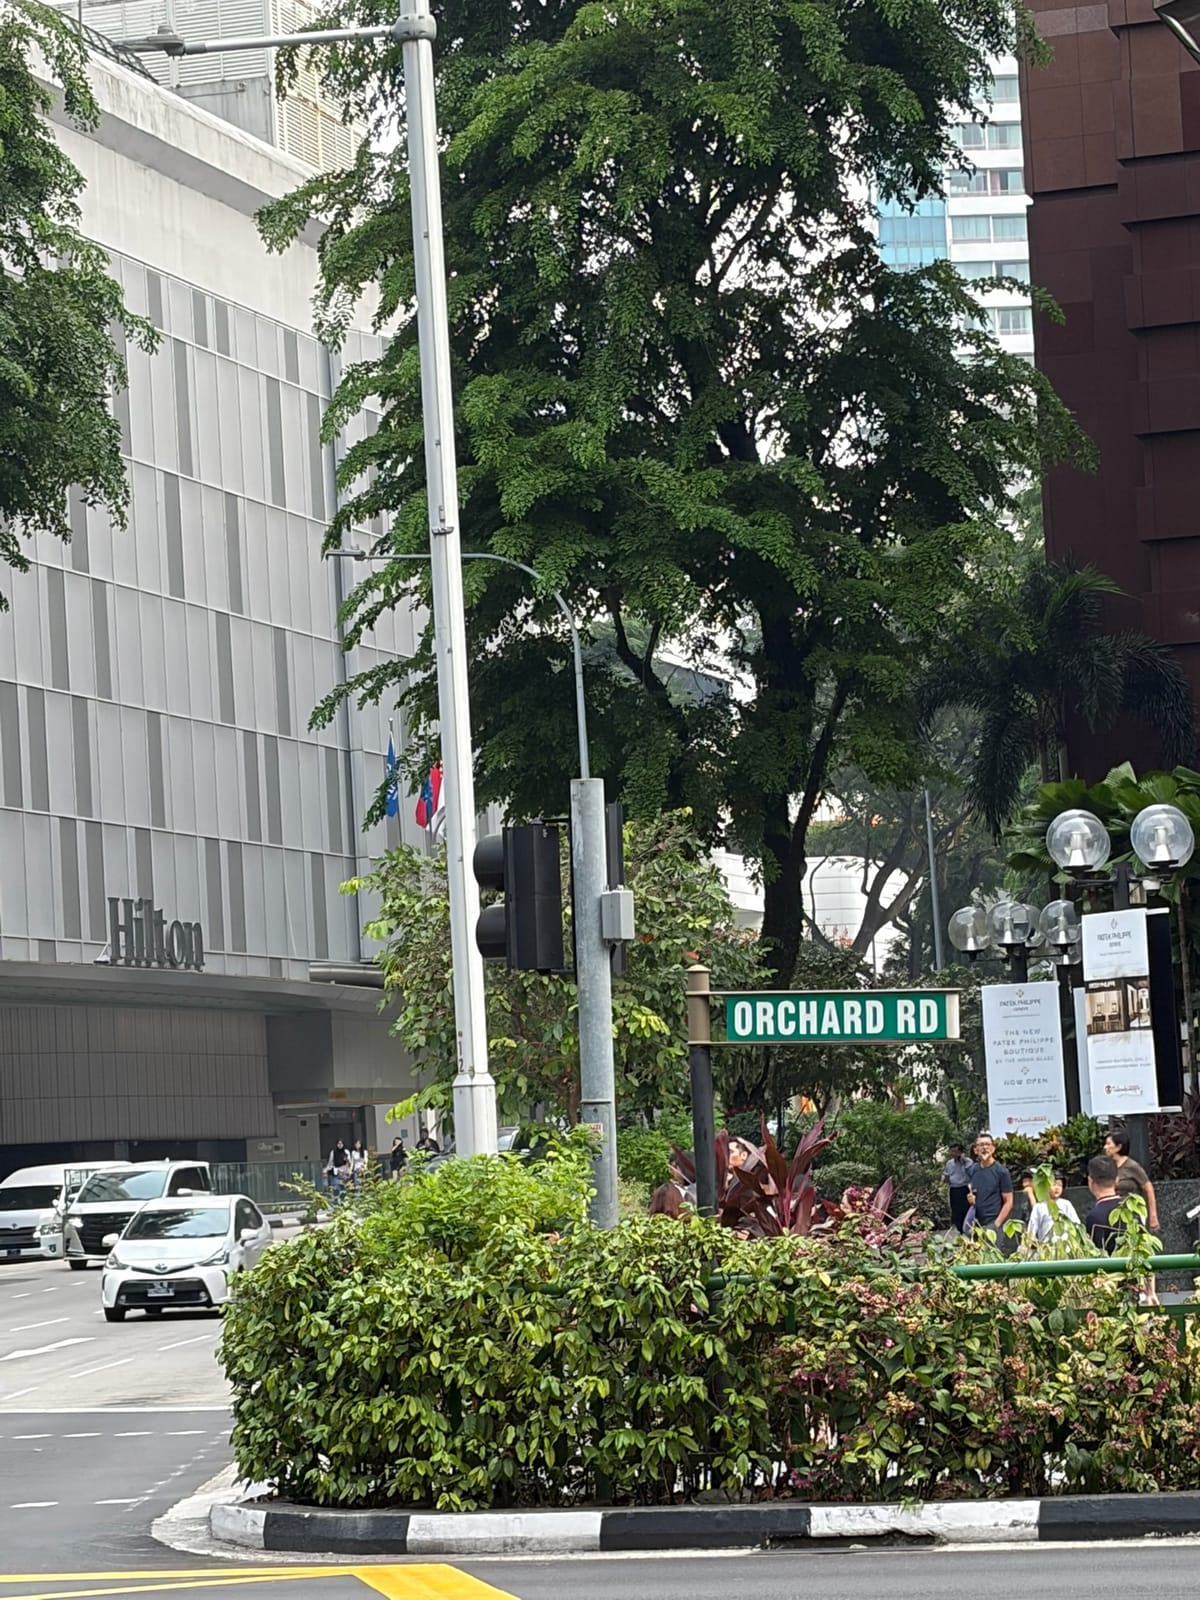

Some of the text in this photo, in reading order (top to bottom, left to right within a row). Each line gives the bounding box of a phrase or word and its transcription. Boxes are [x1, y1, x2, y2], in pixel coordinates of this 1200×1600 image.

[107, 897, 204, 972] Hilton
[734, 999, 938, 1036] ORCHARD RD
[1003, 1047, 1044, 1055] BOUTIQUE
[1019, 1037, 1054, 1045] PHILIPPE
